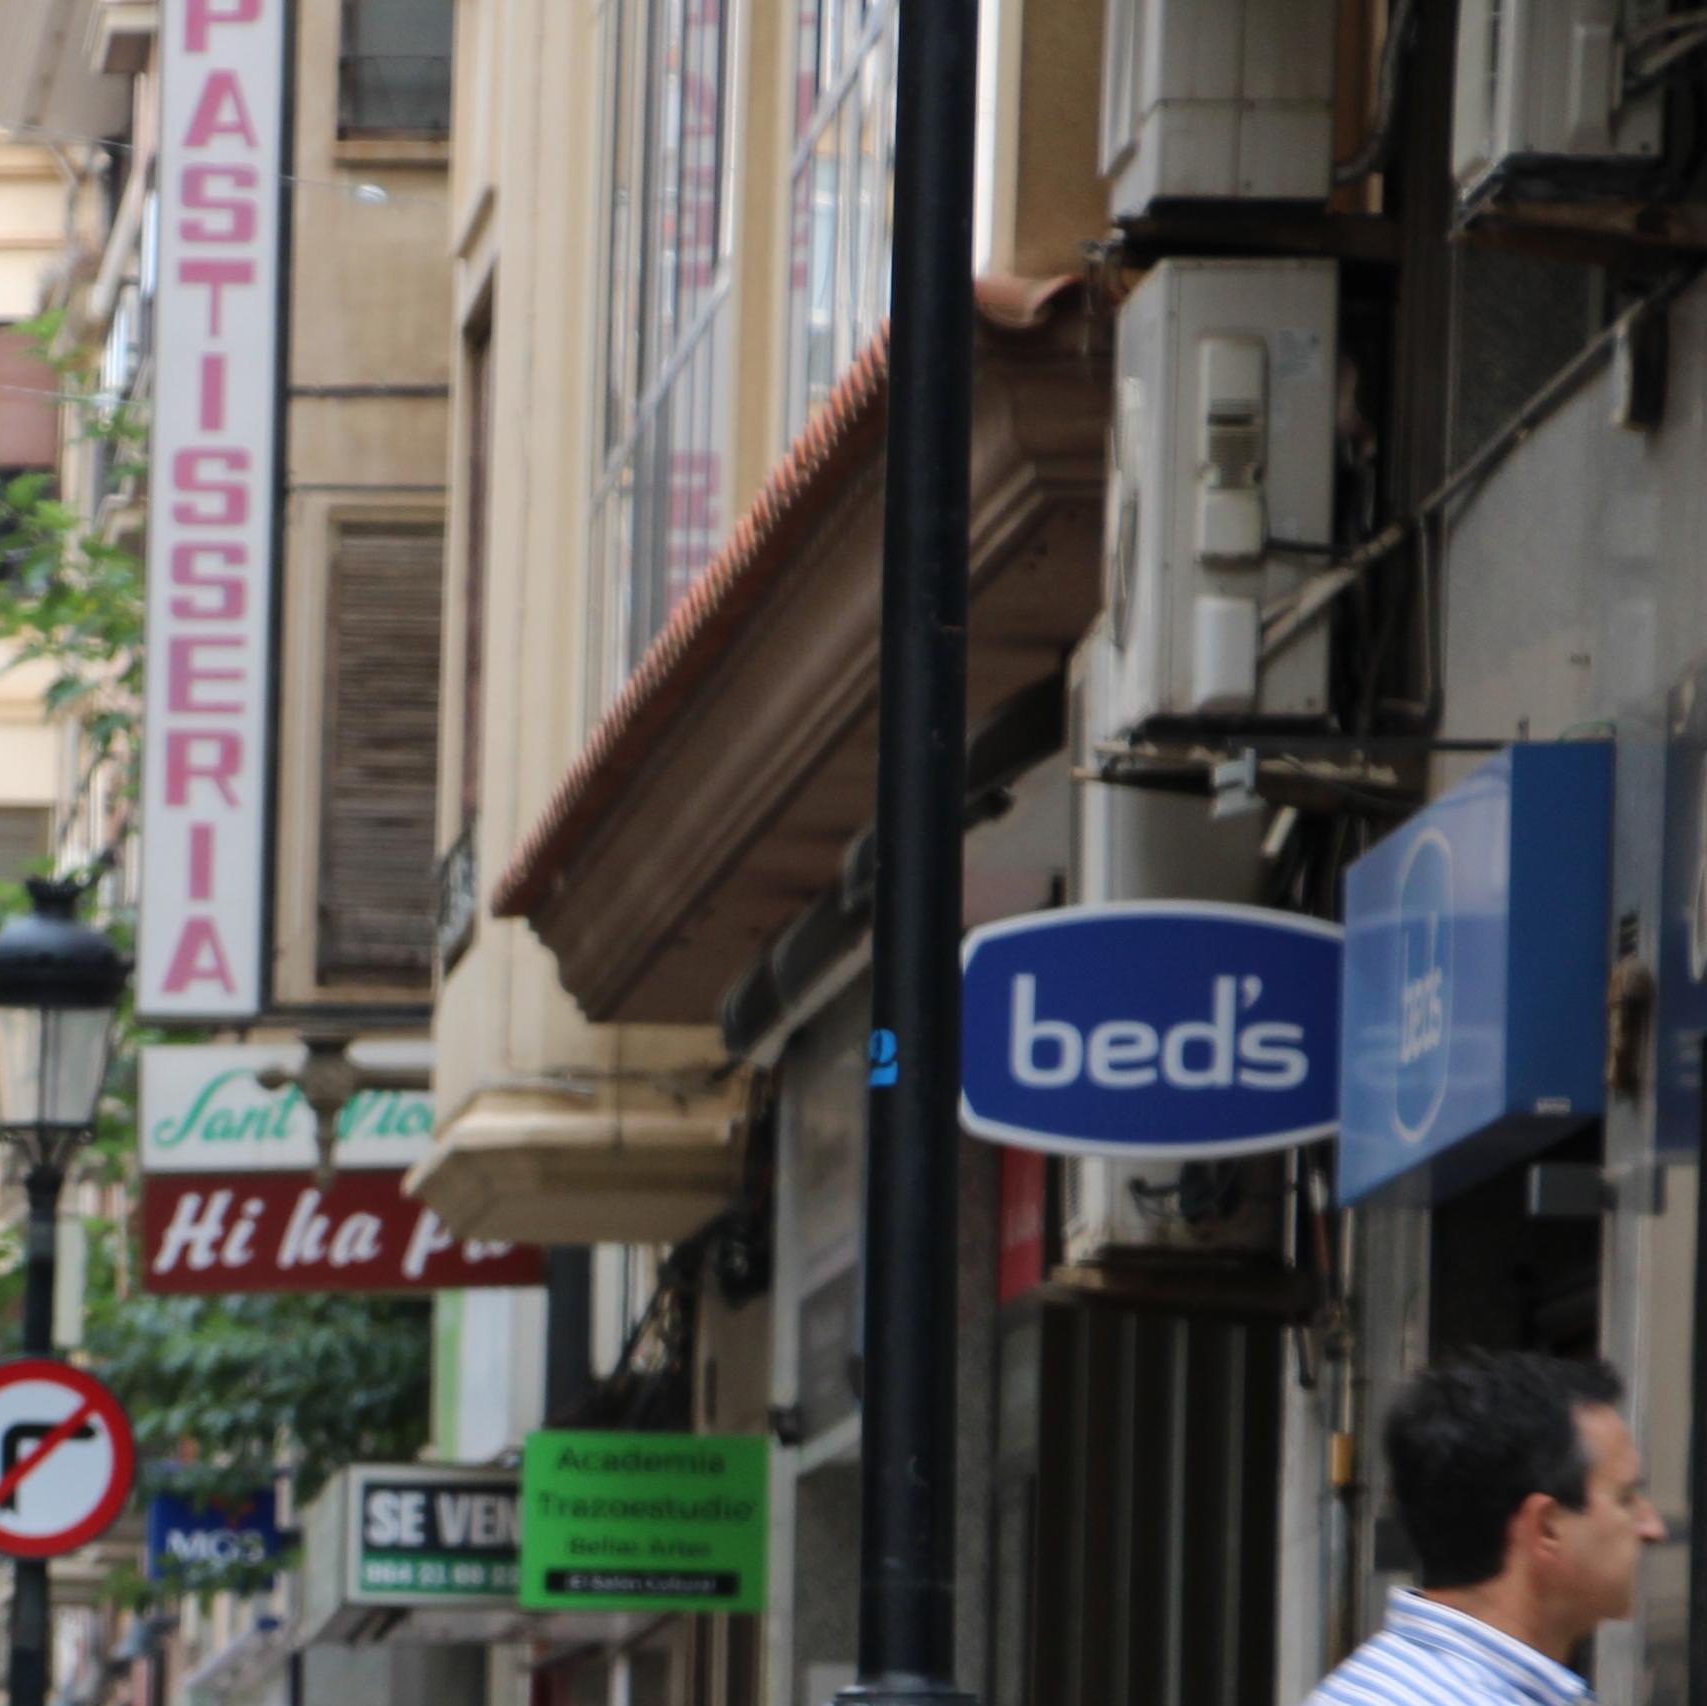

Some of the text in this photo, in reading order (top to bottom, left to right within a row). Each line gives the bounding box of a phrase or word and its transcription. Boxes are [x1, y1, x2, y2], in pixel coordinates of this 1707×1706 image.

[161, 0, 262, 993] PASTISSERIA
[1010, 973, 1310, 1090] bed's
[151, 1189, 265, 1275] Hi
[276, 1187, 383, 1270] ha
[557, 1447, 725, 1475] Academia
[368, 1489, 426, 1547] SE
